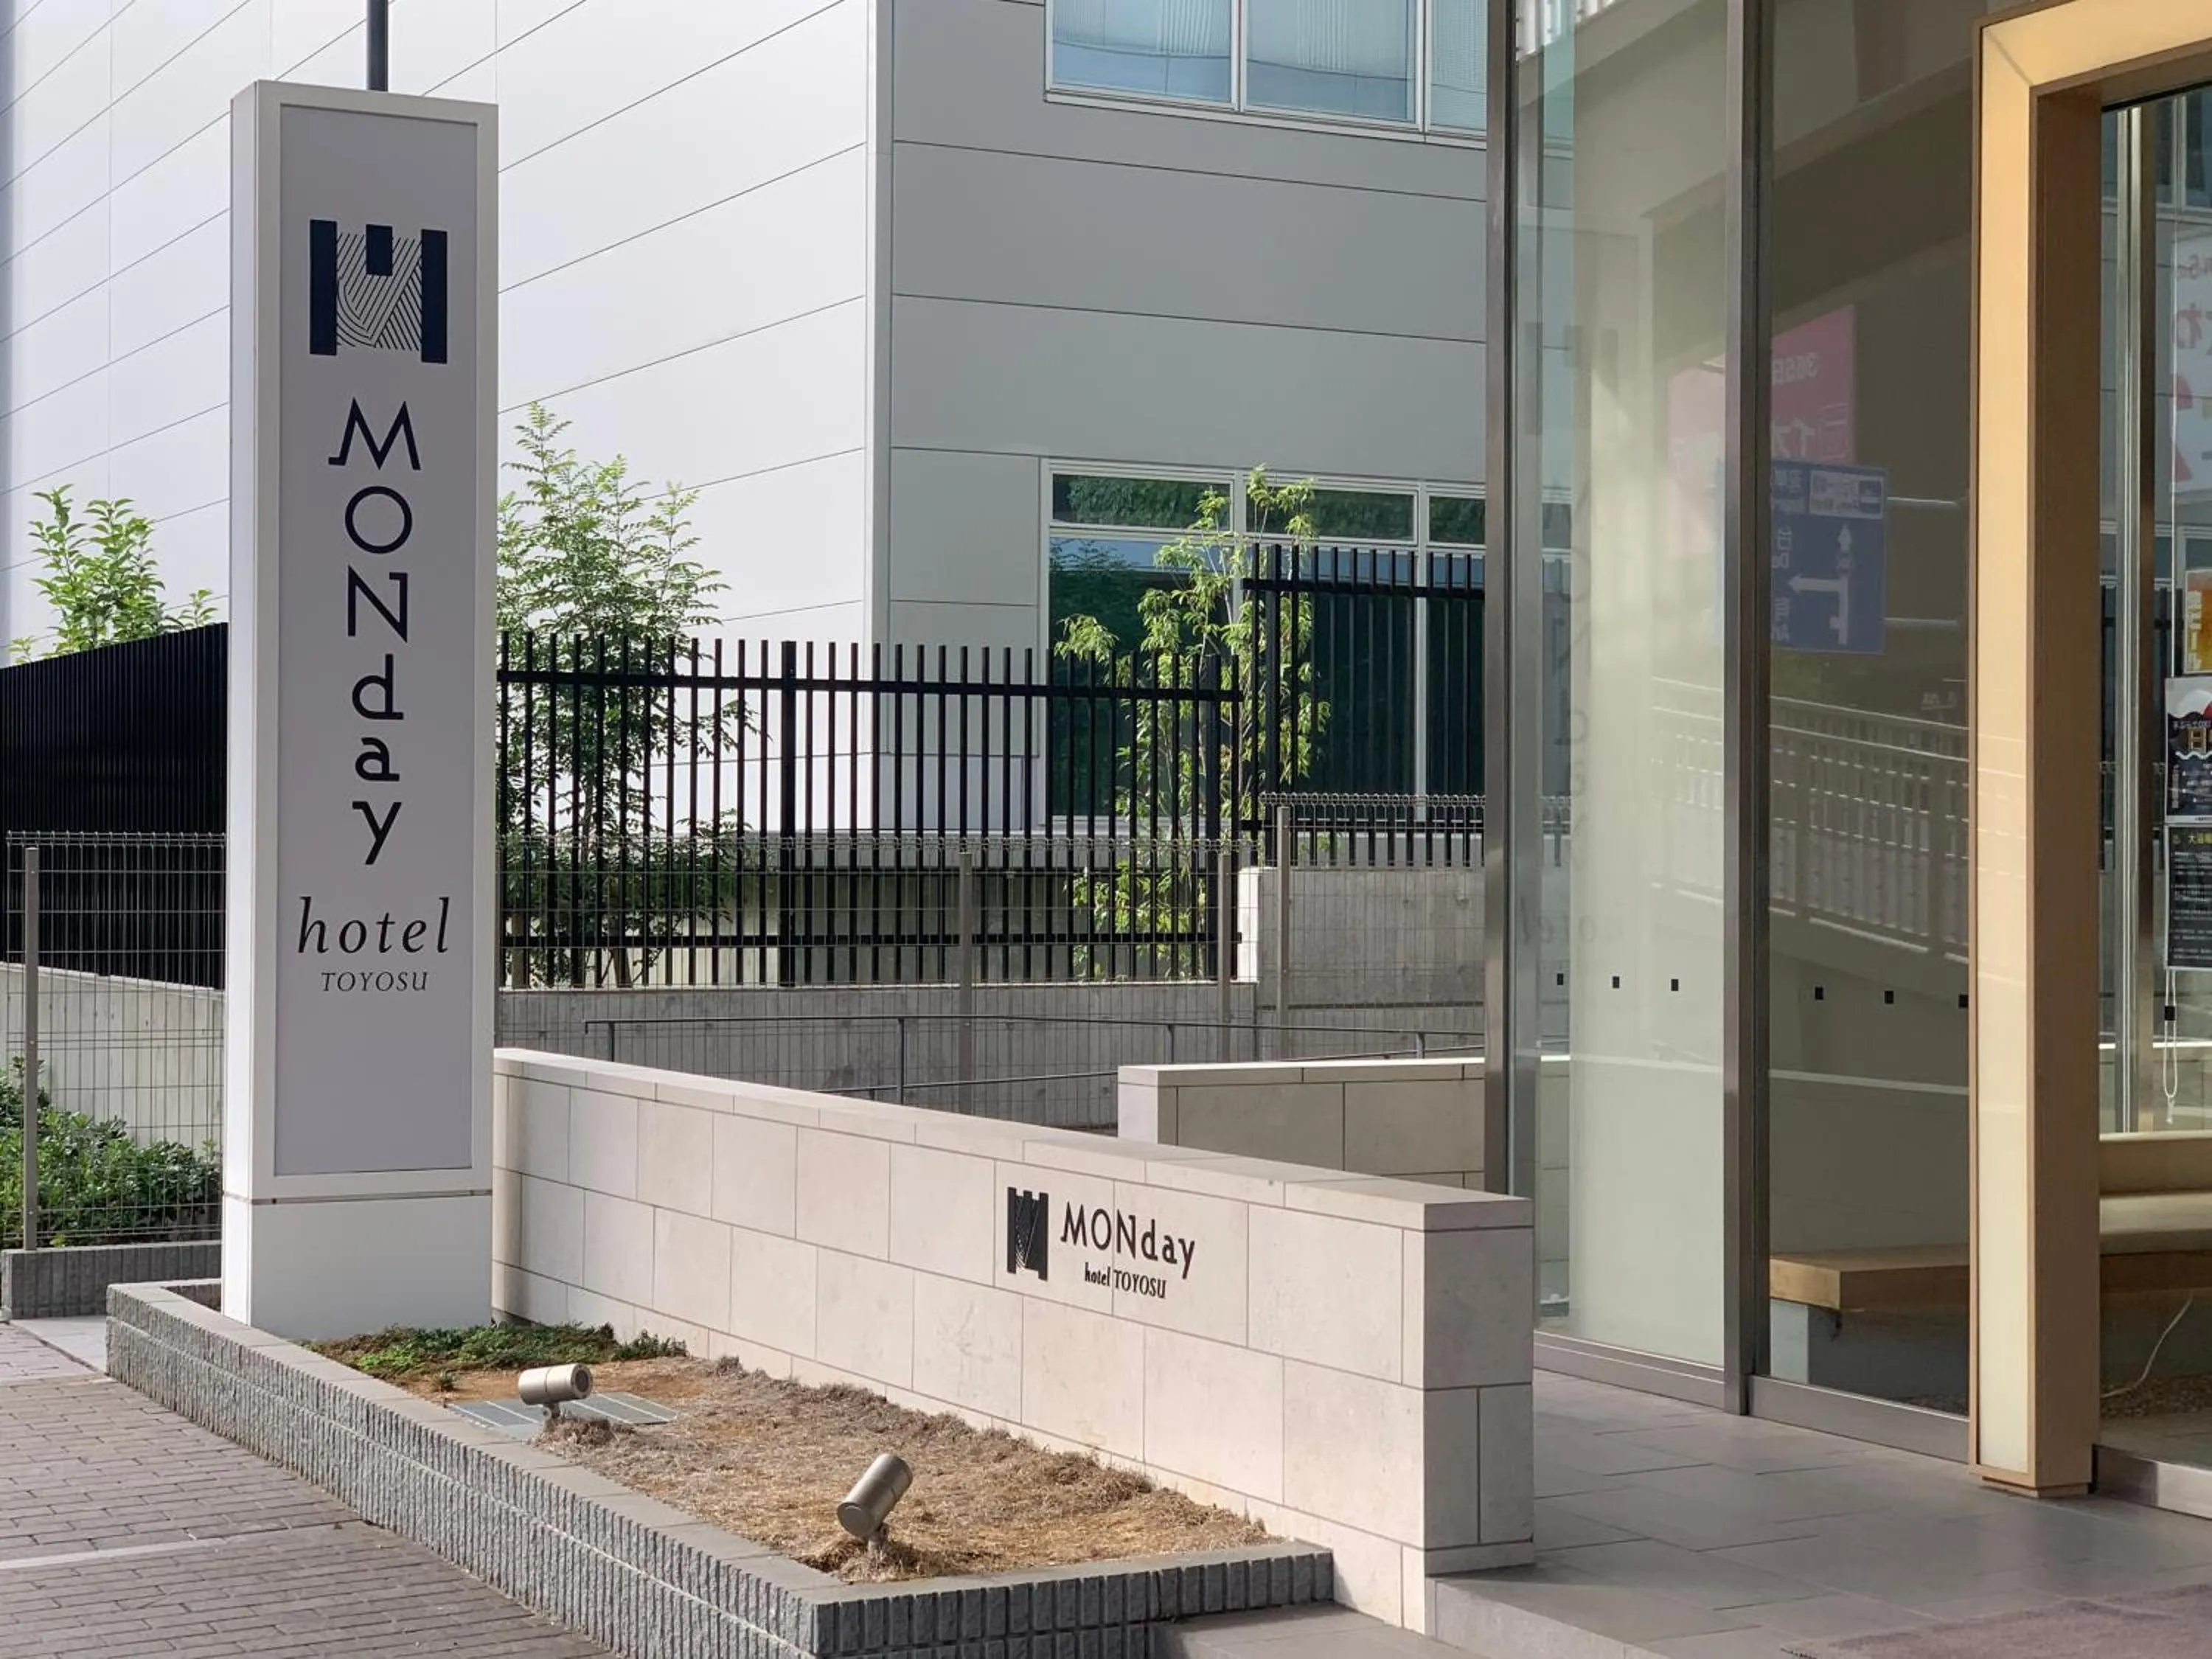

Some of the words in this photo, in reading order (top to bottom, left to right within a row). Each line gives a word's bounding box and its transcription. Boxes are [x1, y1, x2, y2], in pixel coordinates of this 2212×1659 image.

[327, 397, 422, 866] MONday
[298, 896, 449, 954] hotel
[321, 971, 428, 992] TOYOSU
[1060, 1201, 1195, 1279] MONday
[1084, 1262, 1110, 1287] hotel
[1113, 1269, 1166, 1299] TOYOSU
